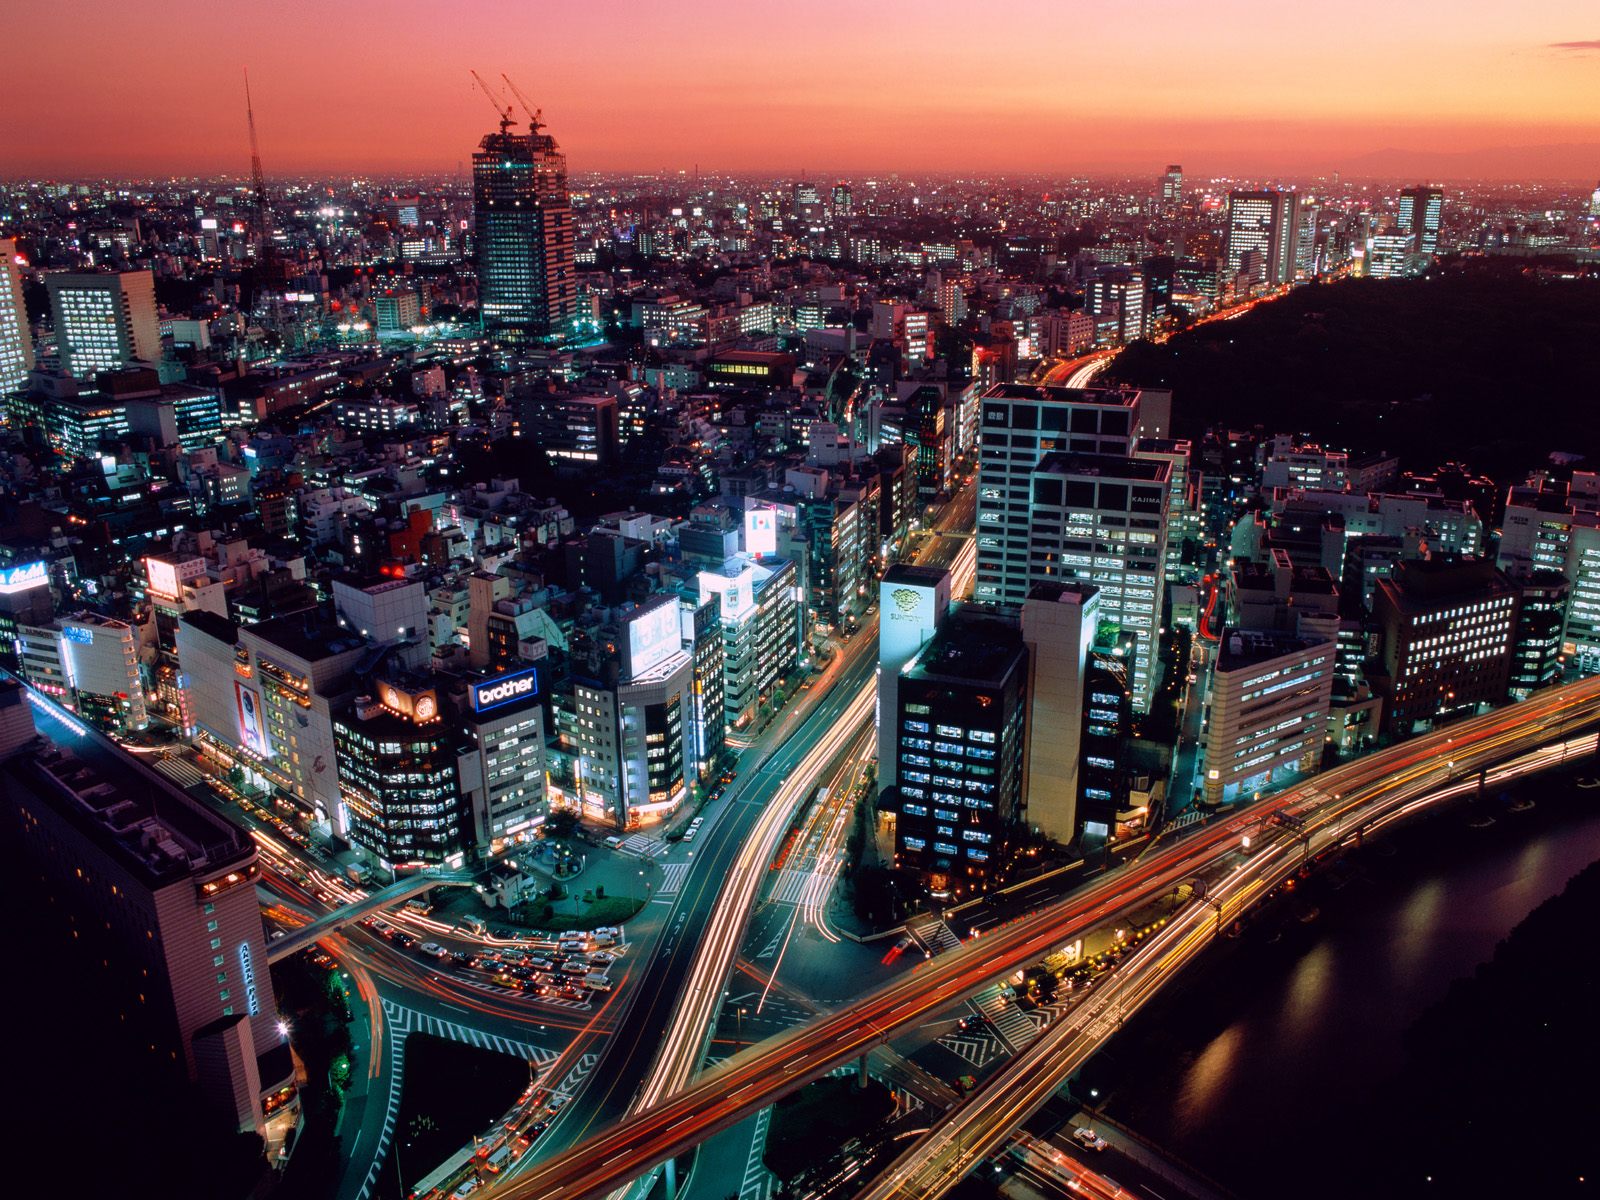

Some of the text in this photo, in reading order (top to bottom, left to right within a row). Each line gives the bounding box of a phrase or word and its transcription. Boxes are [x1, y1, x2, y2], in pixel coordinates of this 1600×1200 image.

[1131, 496, 1161, 504] KAJIMA
[478, 676, 534, 704] brother
[241, 945, 253, 984] Akasaka
